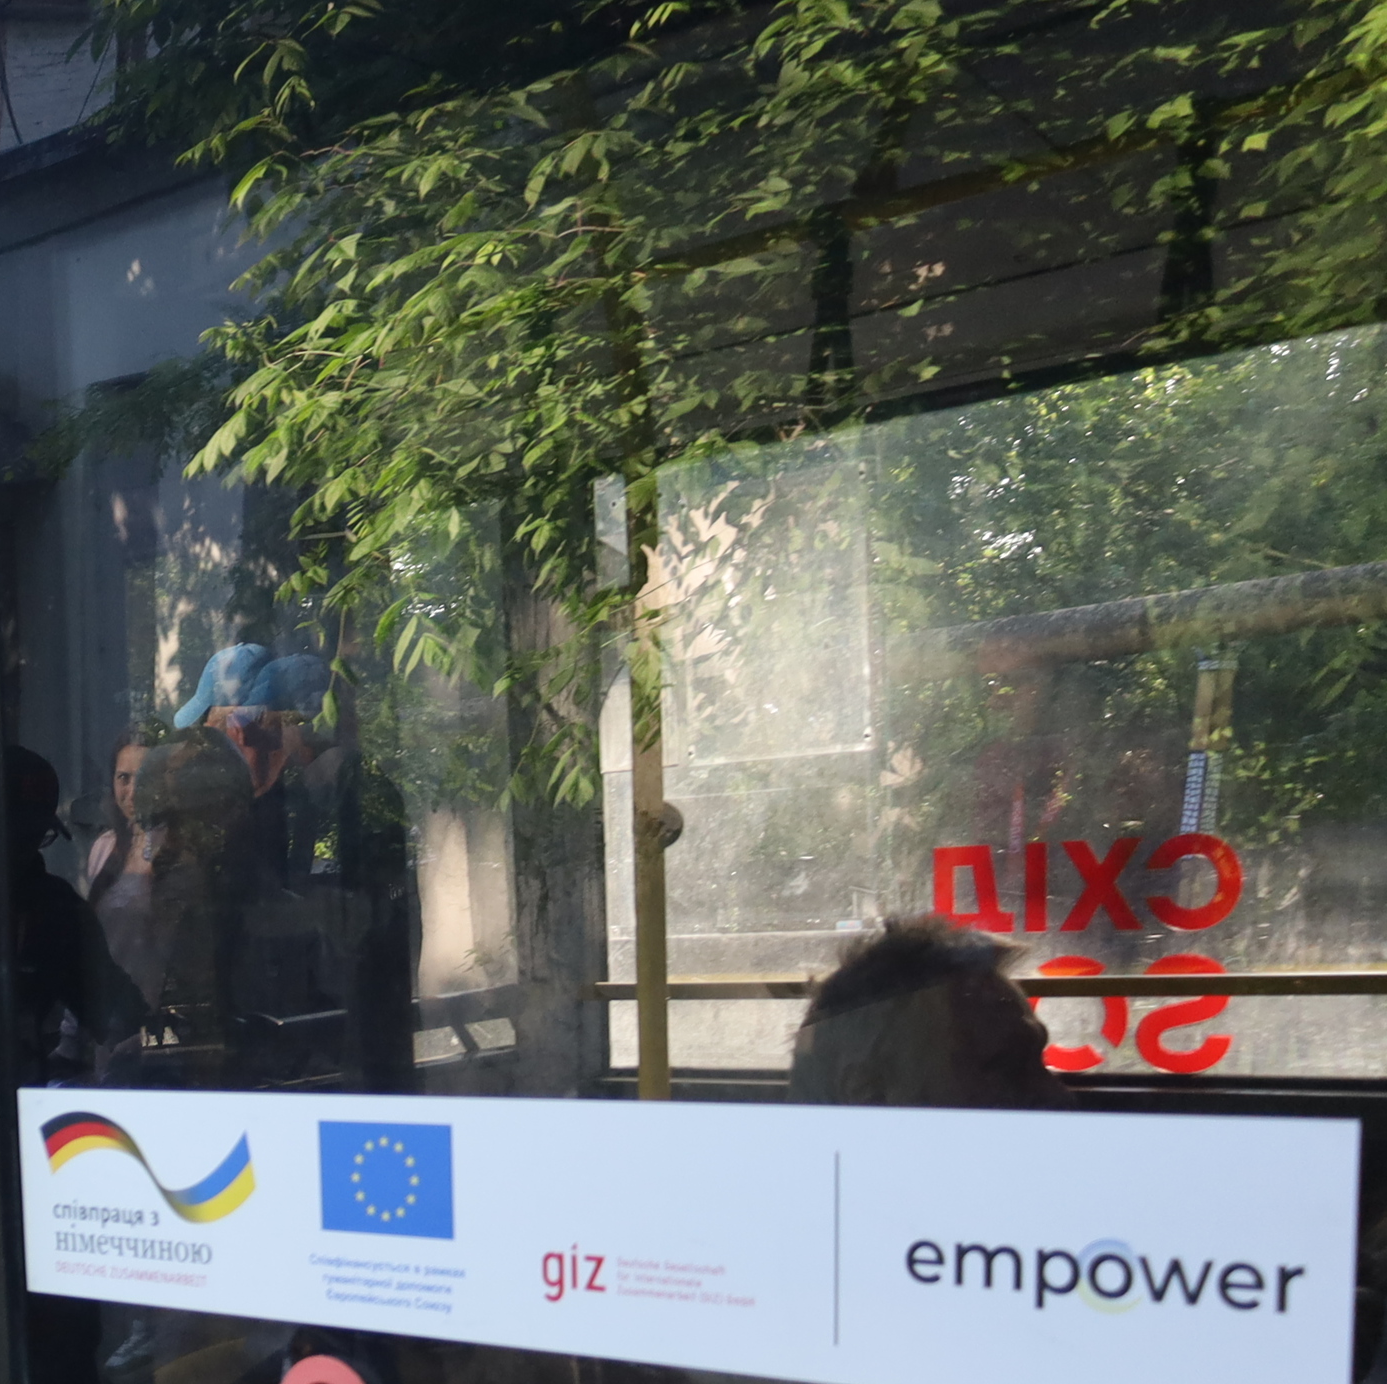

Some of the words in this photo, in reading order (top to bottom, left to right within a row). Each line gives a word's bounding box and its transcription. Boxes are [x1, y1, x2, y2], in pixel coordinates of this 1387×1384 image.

[53, 1200, 144, 1228] співпраця
[150, 1210, 160, 1226] з
[55, 1223, 213, 1265] німеччиною
[542, 1242, 606, 1303] giz
[905, 1239, 1306, 1313] empower
